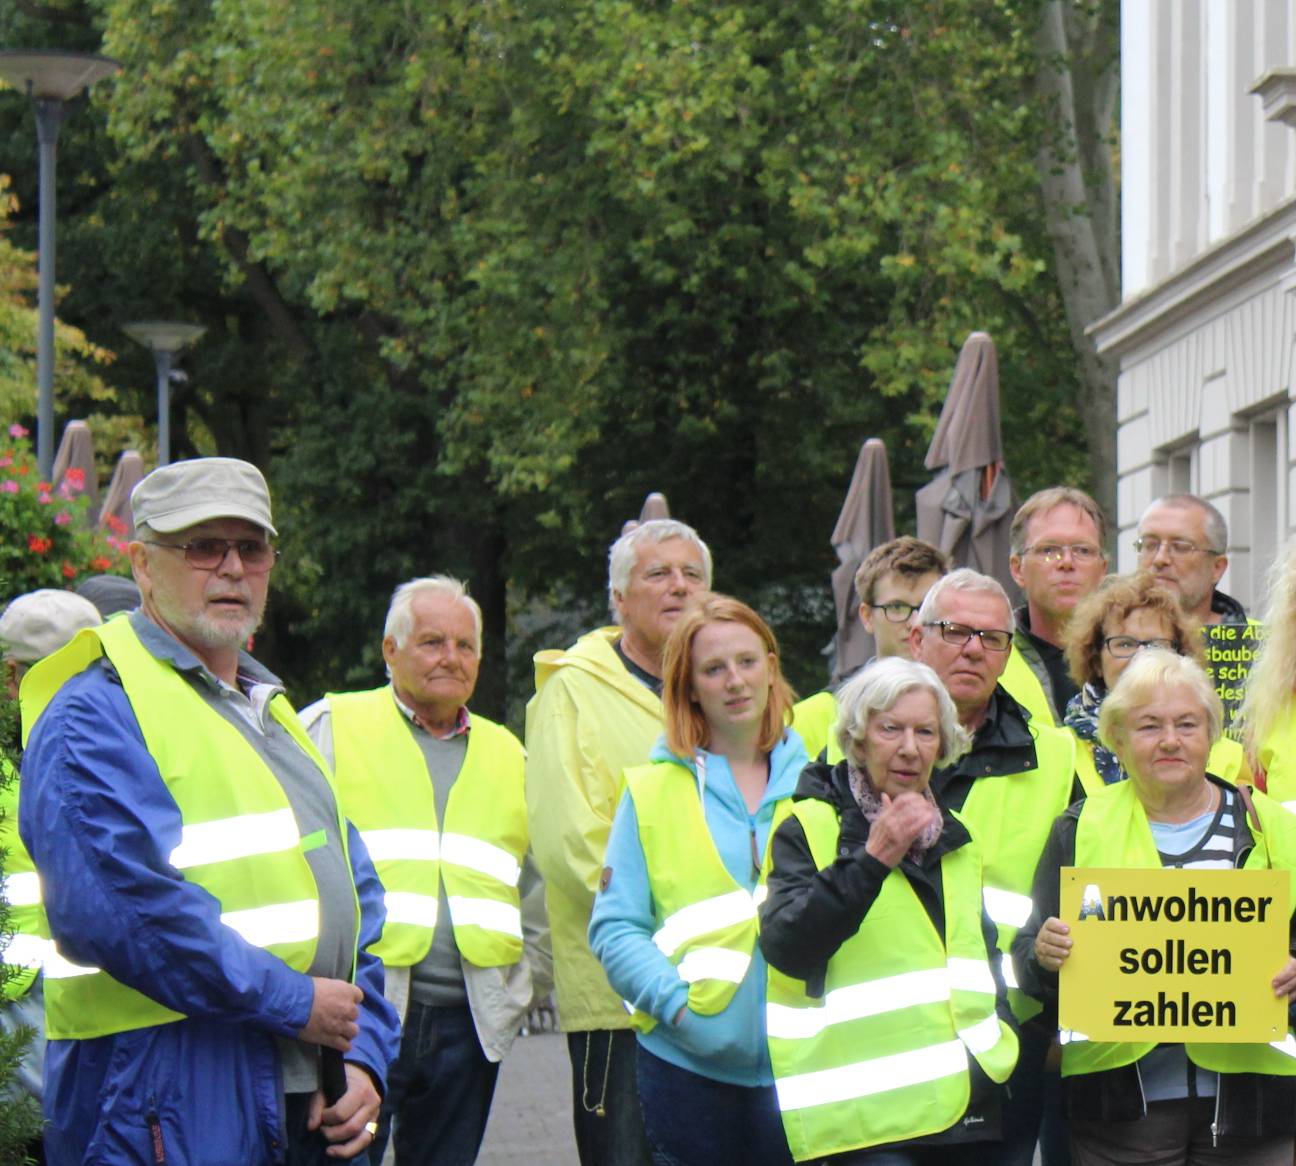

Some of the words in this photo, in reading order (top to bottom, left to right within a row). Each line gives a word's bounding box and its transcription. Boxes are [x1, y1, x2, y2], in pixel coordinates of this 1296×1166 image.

[1210, 625, 1236, 641] die
[1204, 645, 1262, 662] sbaube
[1218, 663, 1249, 681] sch
[1078, 884, 1272, 923] Anwohner
[1119, 939, 1232, 975] sollen
[1113, 991, 1237, 1028] zahlen
